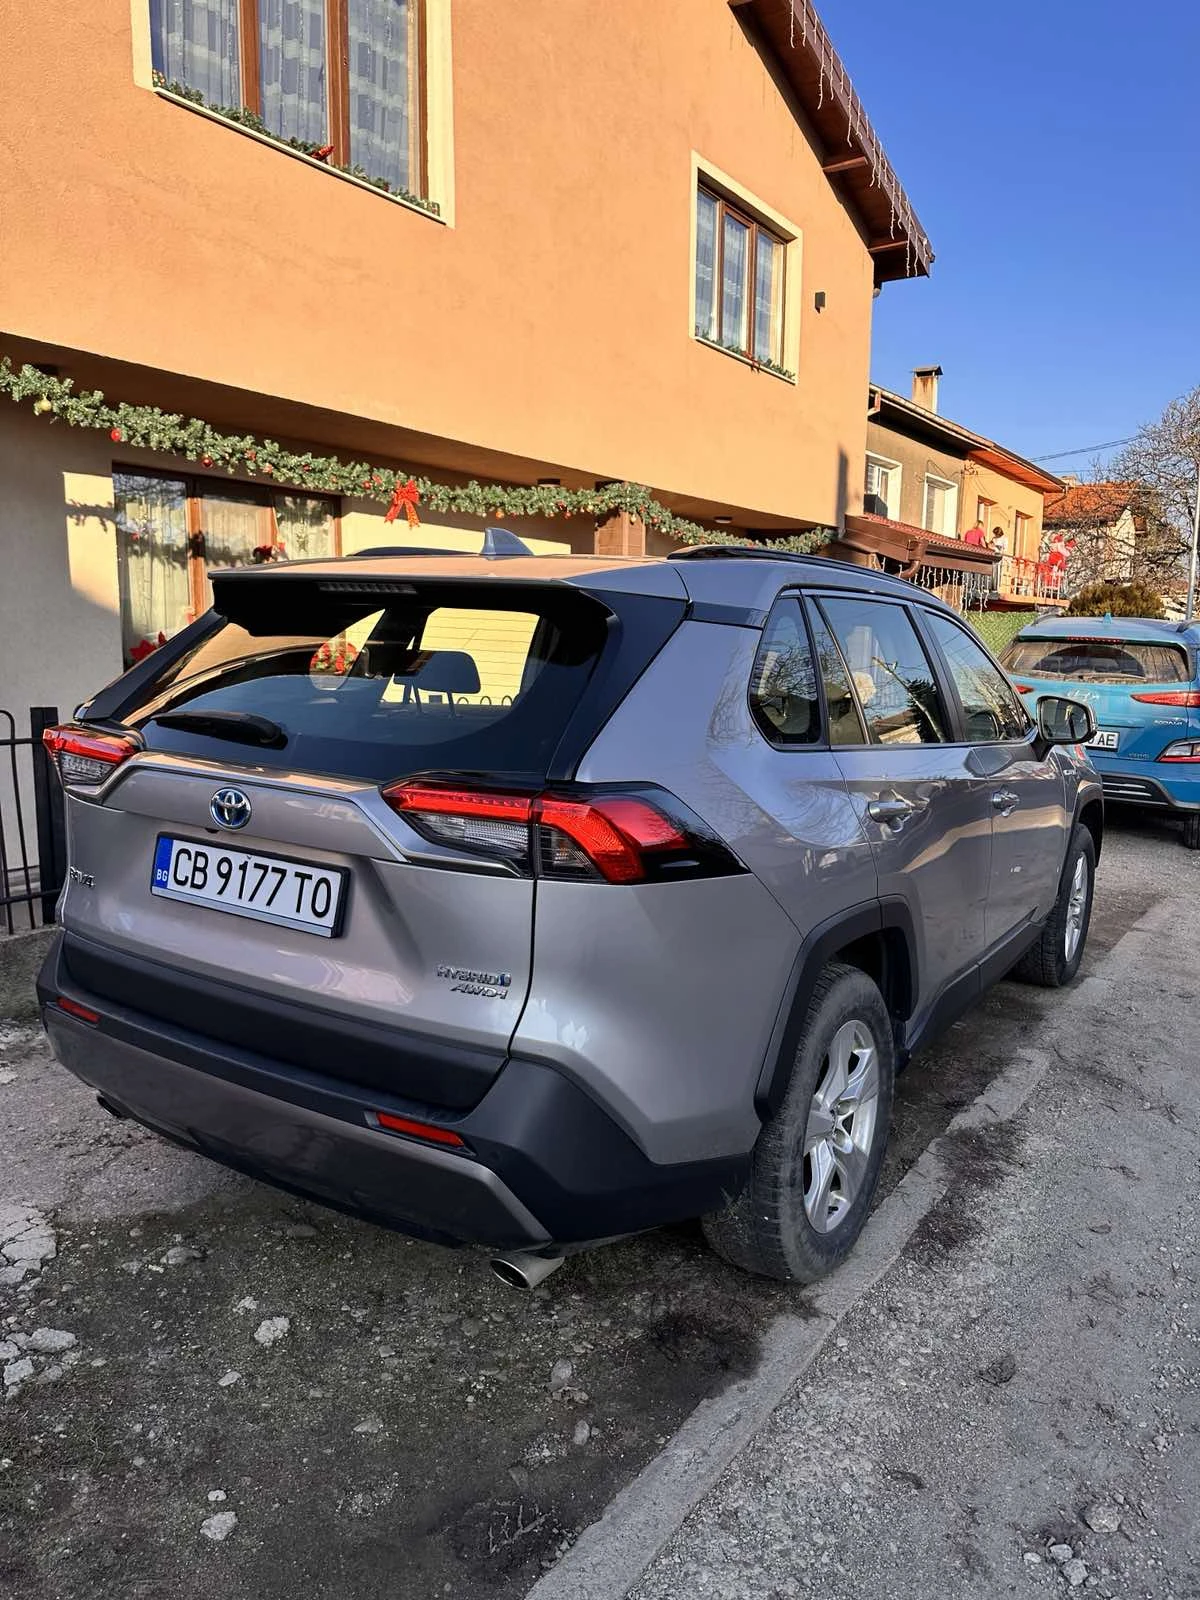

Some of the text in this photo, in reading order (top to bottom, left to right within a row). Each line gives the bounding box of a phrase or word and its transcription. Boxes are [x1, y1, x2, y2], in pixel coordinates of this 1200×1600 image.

[1097, 733, 1116, 747] AE
[156, 868, 168, 883] BG
[172, 848, 209, 890] CB
[216, 856, 288, 907] 9177
